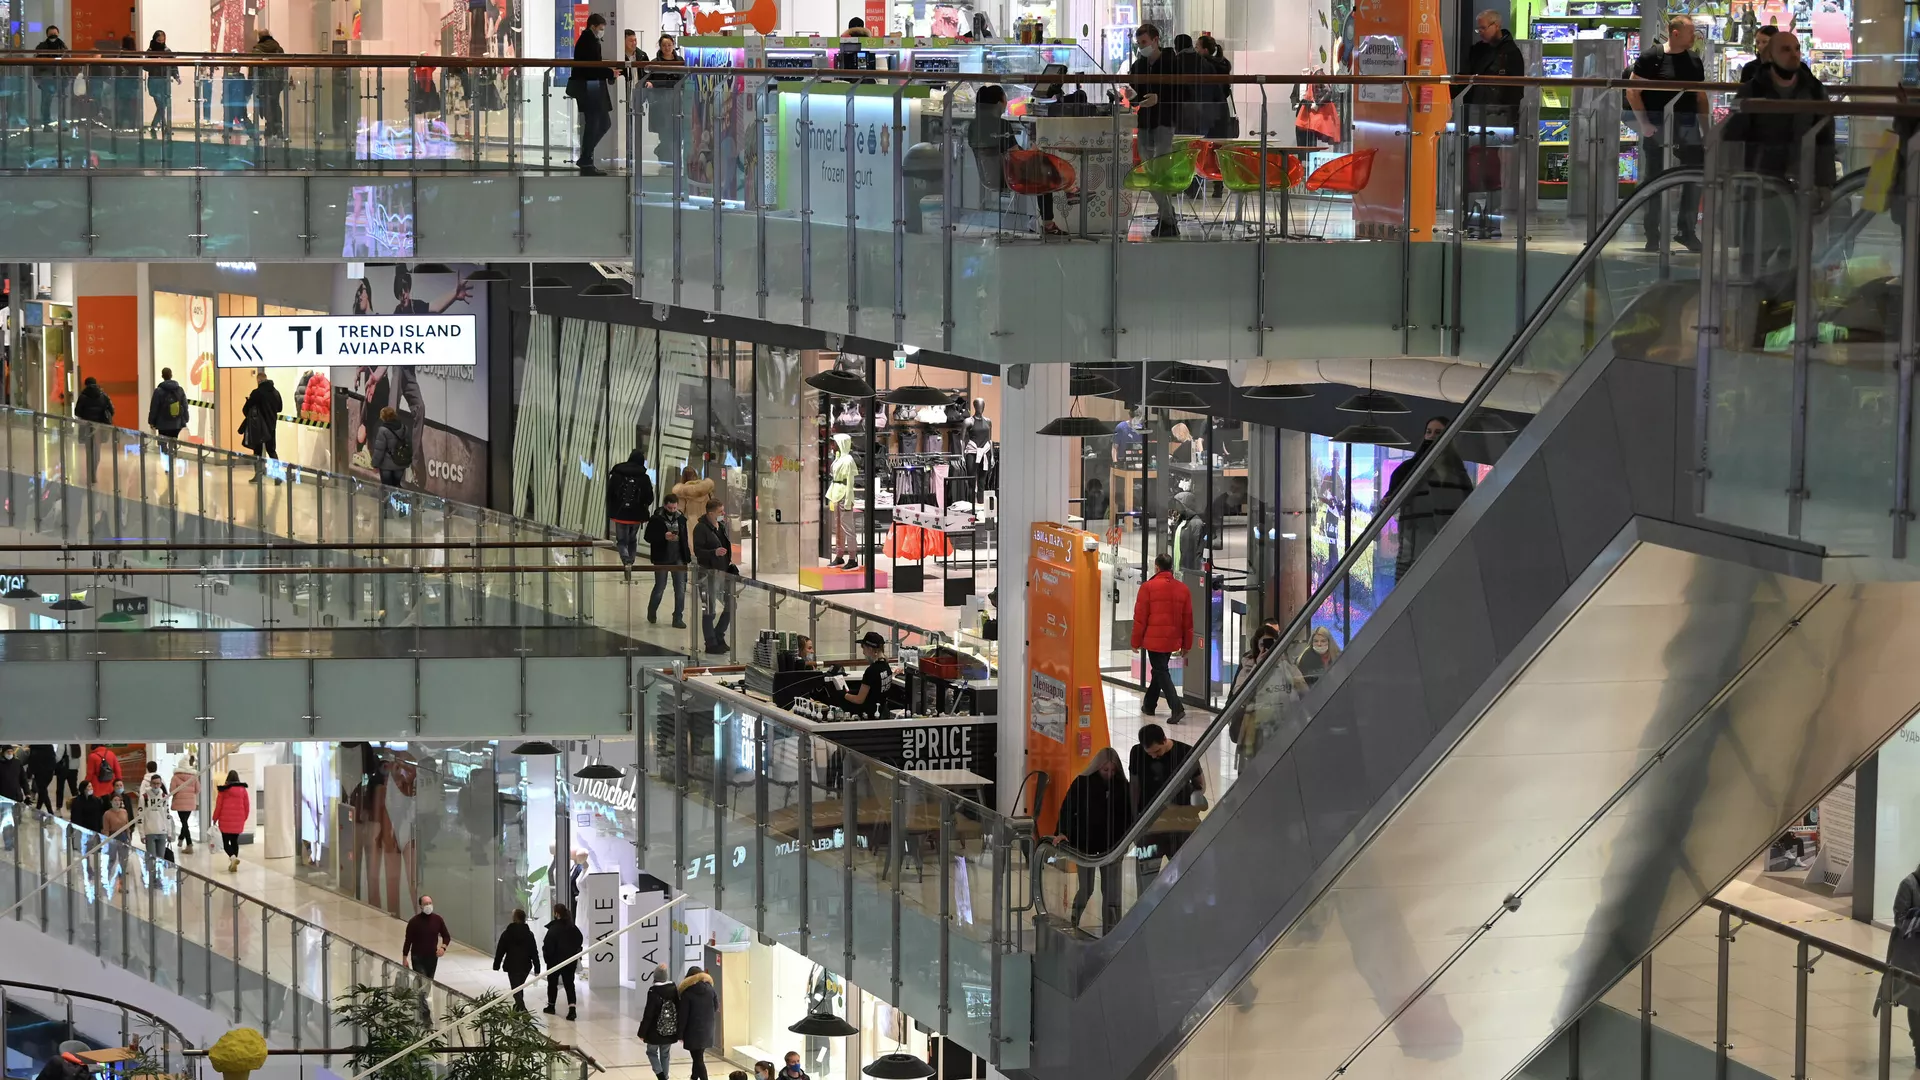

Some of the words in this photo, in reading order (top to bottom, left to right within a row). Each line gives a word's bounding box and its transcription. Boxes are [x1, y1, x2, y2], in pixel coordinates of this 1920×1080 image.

[795, 118, 837, 152] Smmer
[839, 121, 864, 154] Le
[821, 160, 845, 184] frozen
[338, 324, 395, 339] TREND
[399, 323, 463, 338] ISLAND
[338, 341, 426, 355] AVIAPARK
[428, 459, 464, 483] crocs
[1065, 540, 1073, 563] 3
[902, 729, 915, 760] ONE
[915, 726, 973, 759] PRICE
[594, 898, 614, 963] SALE
[684, 934, 702, 962] LE
